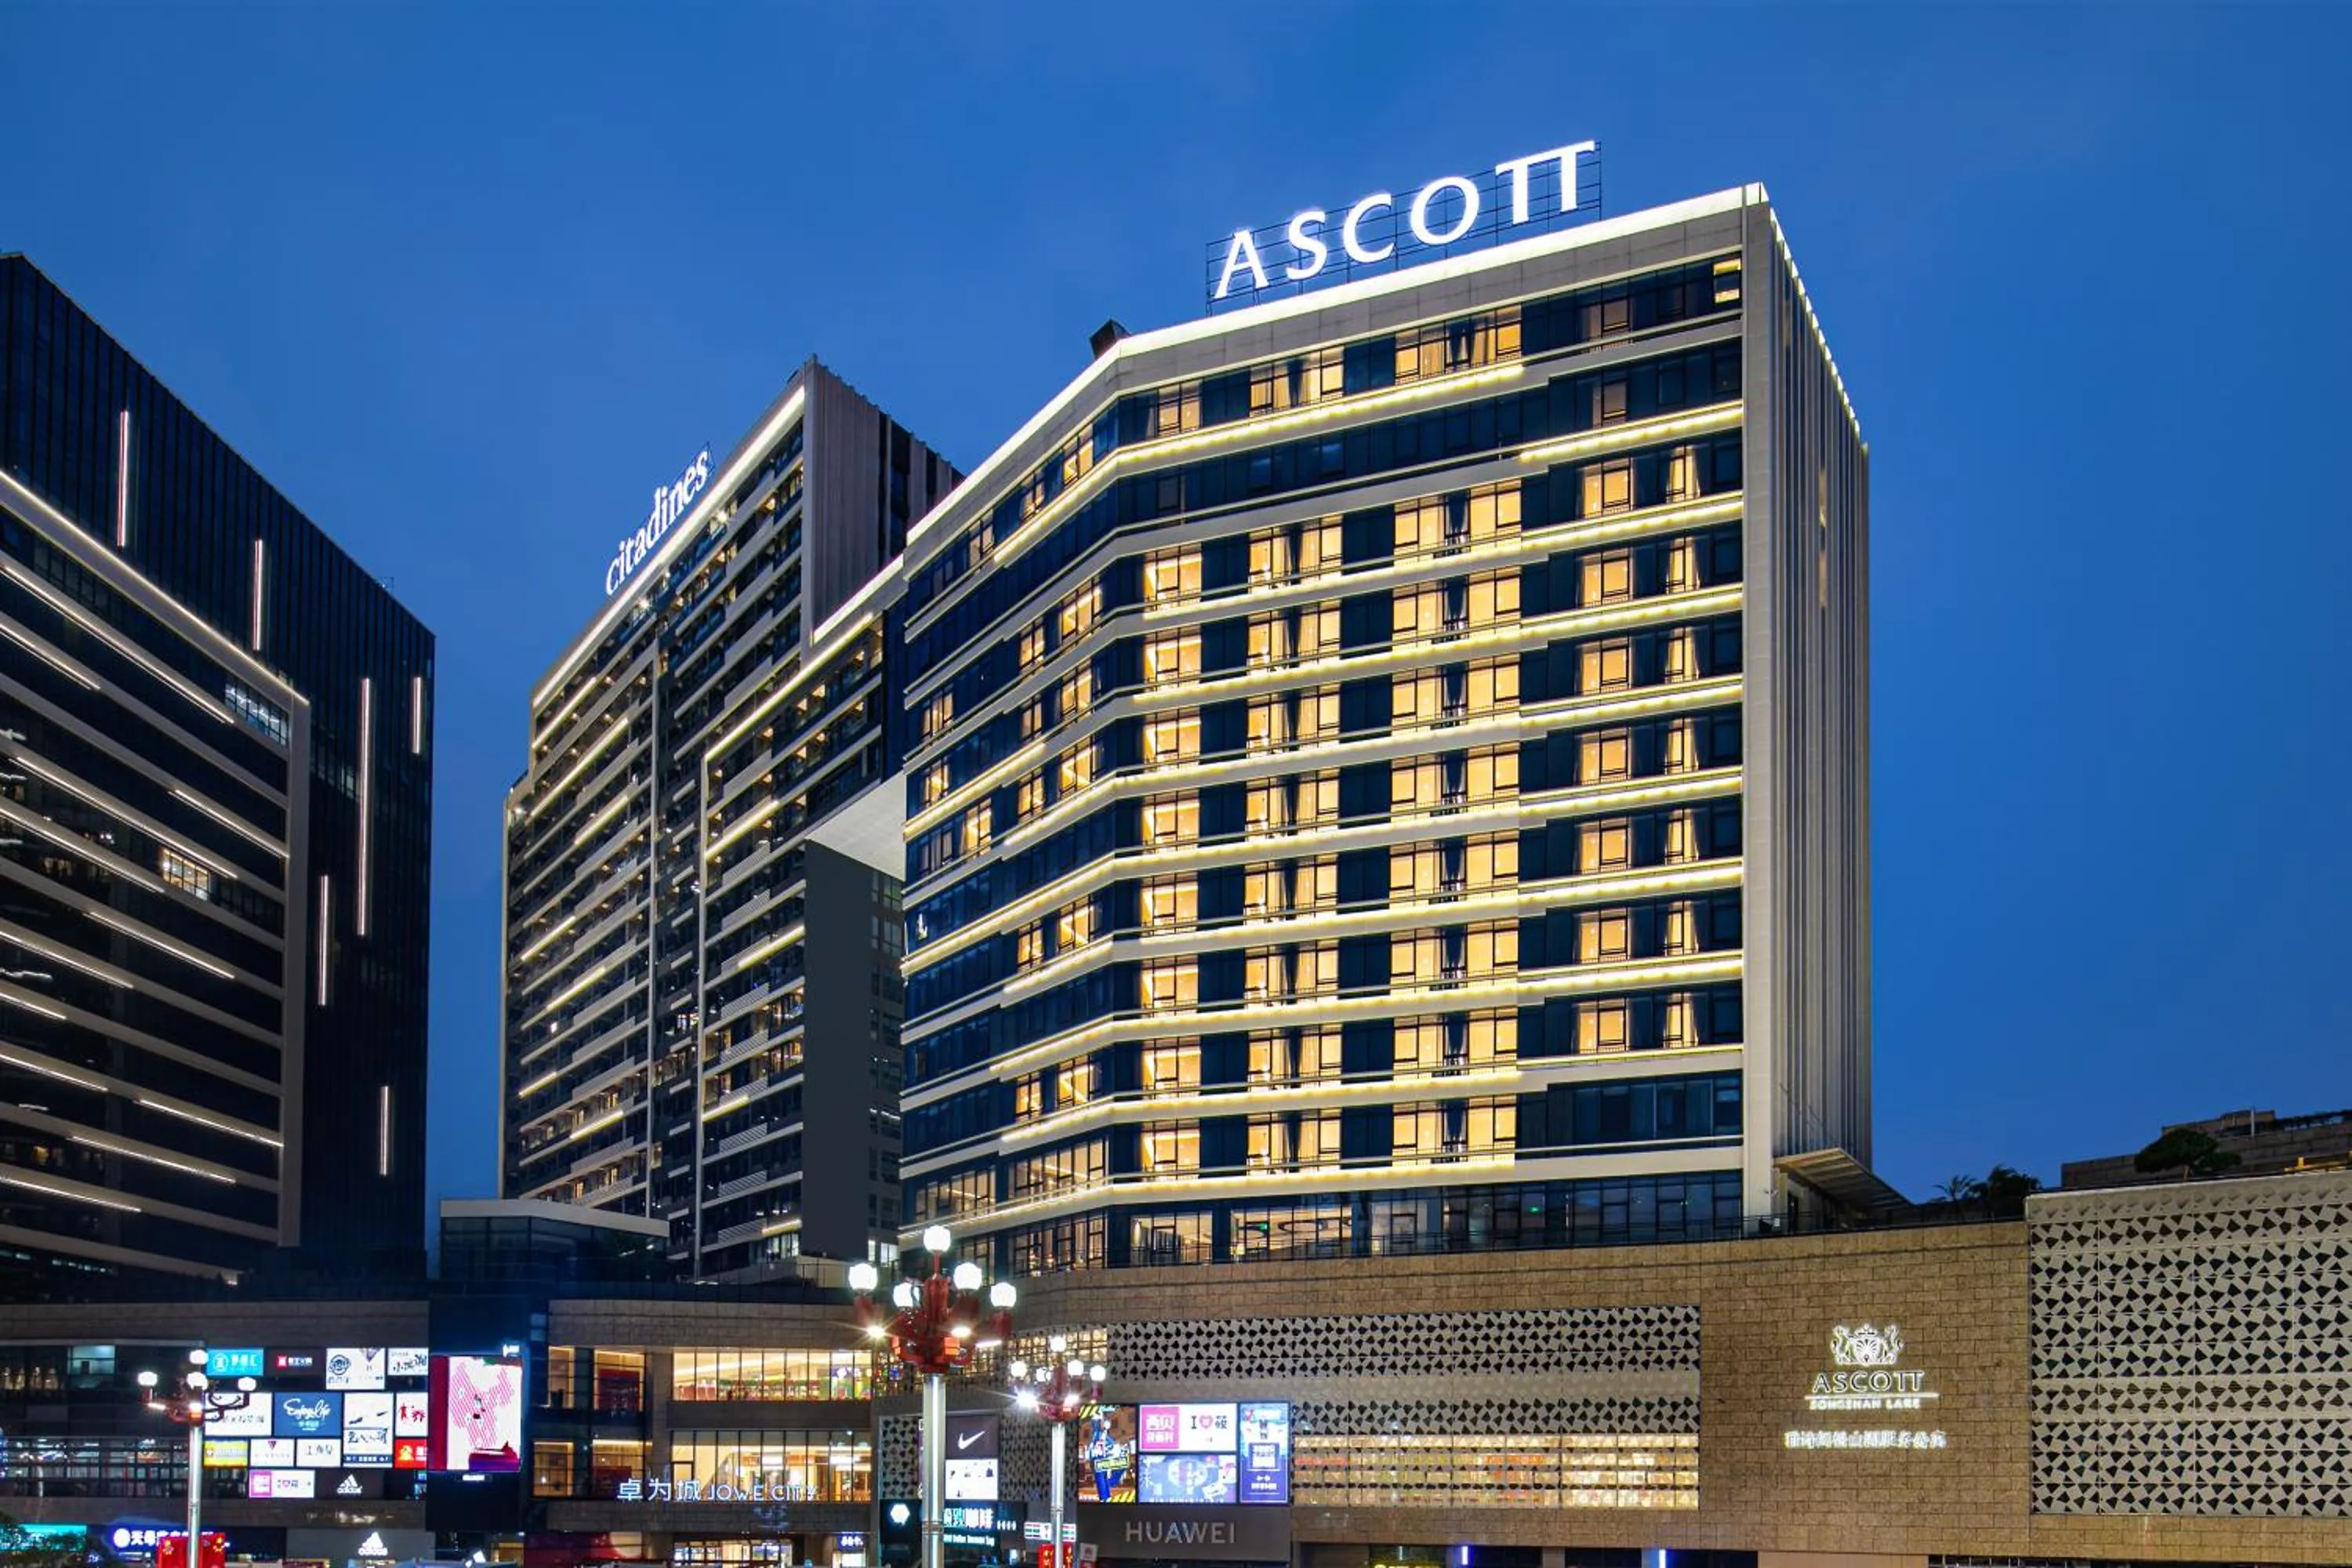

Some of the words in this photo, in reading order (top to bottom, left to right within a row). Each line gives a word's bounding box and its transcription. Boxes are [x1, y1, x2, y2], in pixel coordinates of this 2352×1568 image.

[1214, 140, 1595, 299] ASCOTT
[1812, 1370, 1925, 1393] ASCOTT
[617, 1478, 701, 1502] 卓为城
[1126, 1522, 1236, 1544] HUAWEI
